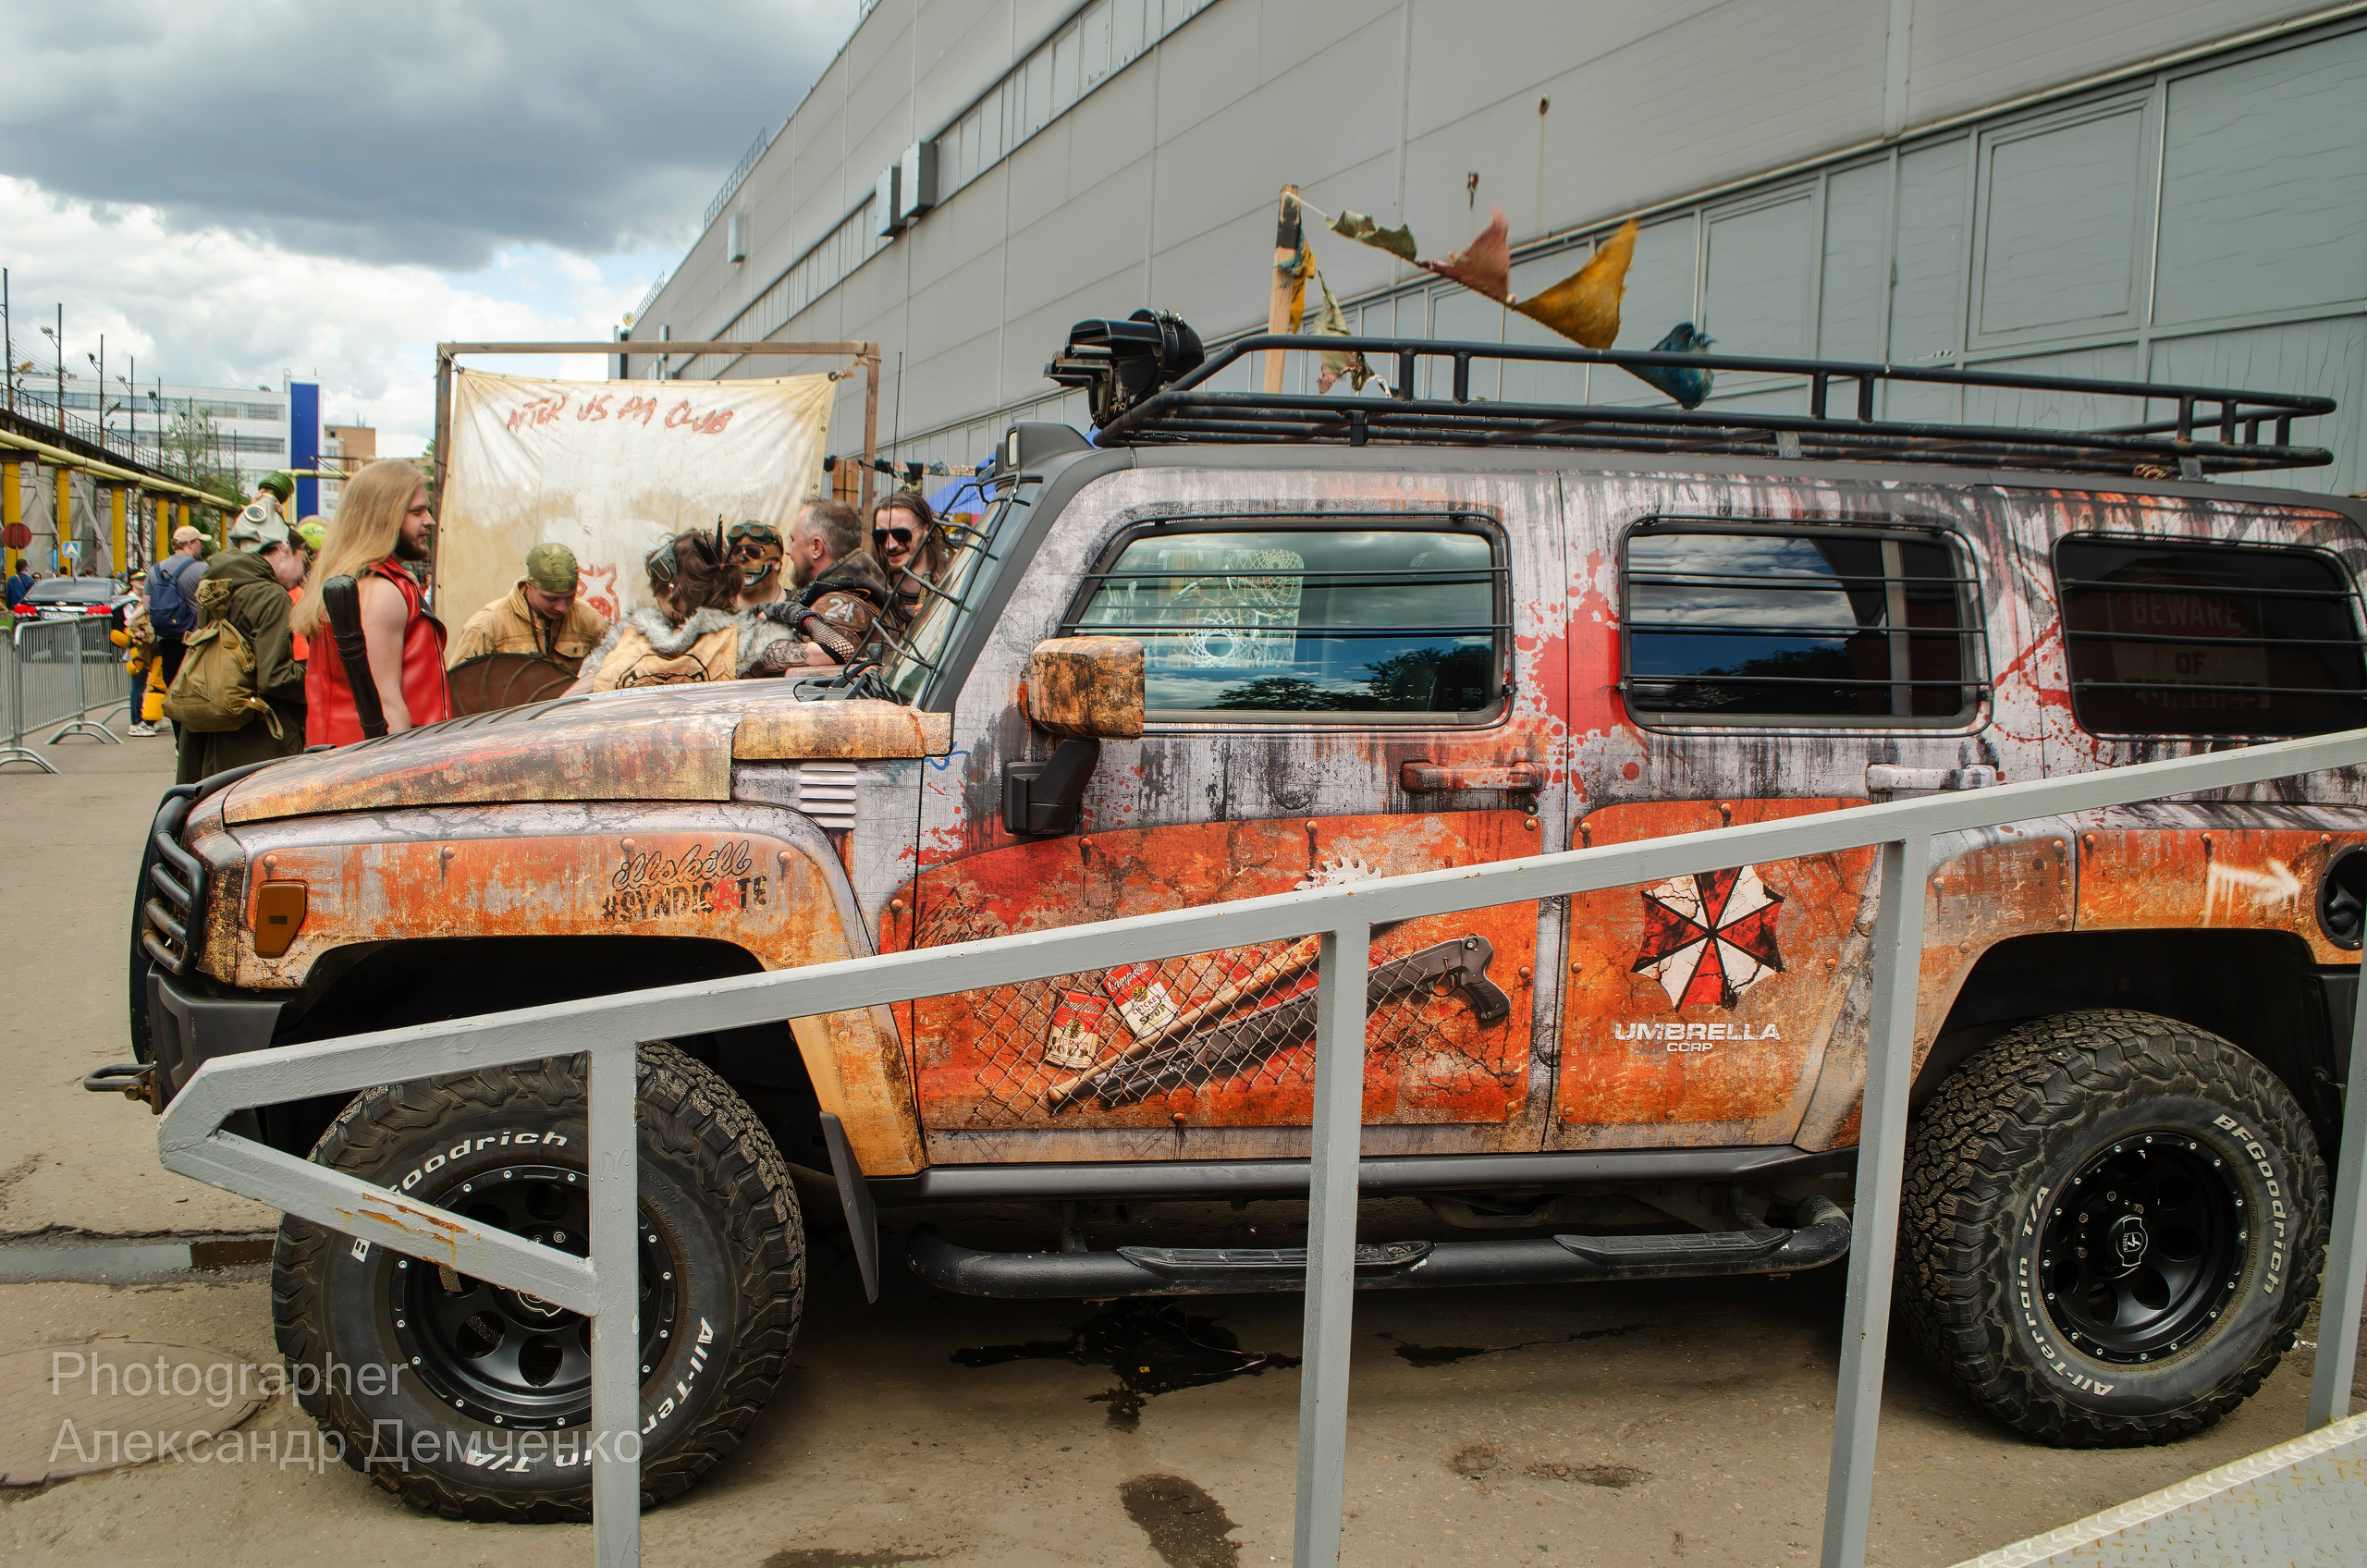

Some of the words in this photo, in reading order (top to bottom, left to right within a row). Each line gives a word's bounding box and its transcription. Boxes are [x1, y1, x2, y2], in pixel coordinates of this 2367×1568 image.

[577, 395, 613, 422] US
[664, 400, 733, 434] CLUB
[825, 597, 854, 622] 24
[2131, 590, 2241, 630] BEWARE
[2175, 651, 2207, 675] OF
[1613, 1023, 1781, 1040] UMBRELLA
[1666, 1042, 1713, 1052] CORP
[2022, 1186, 2050, 1237] T/A
[2213, 1113, 2288, 1294] BFGoodrich
[2017, 1257, 2115, 1396] All-Terrain
